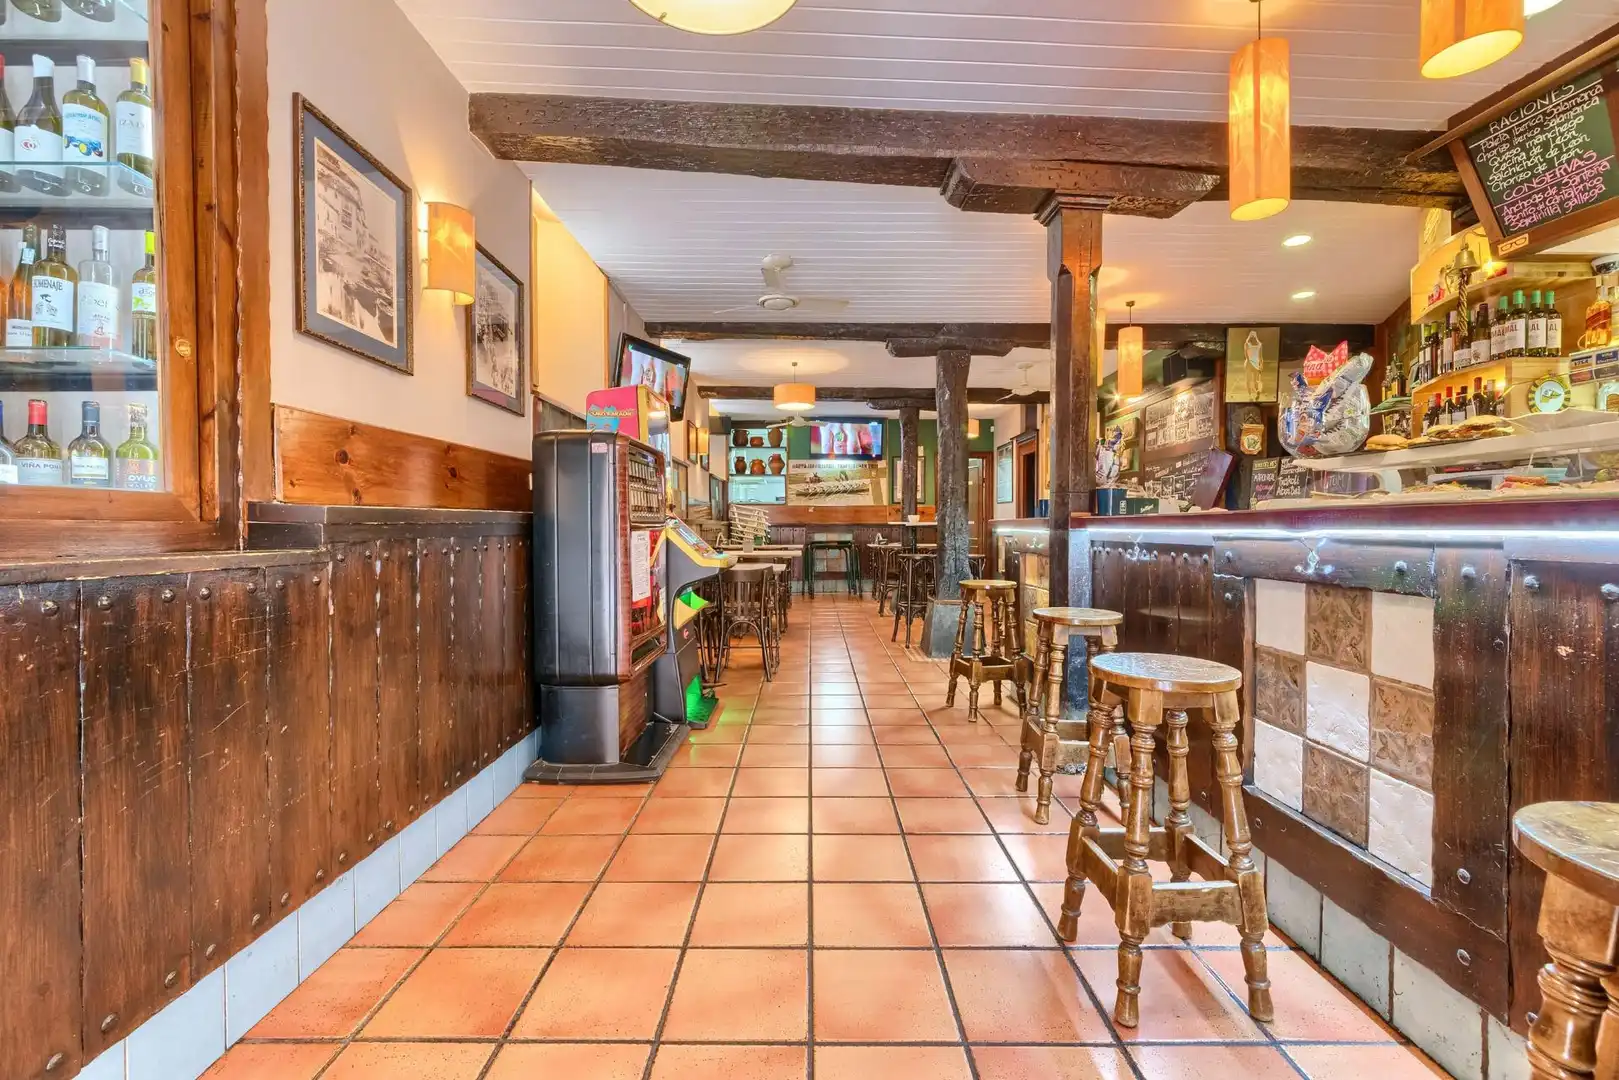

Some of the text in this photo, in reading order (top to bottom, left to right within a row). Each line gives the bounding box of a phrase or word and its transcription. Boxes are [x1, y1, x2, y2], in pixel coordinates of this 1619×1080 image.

[1489, 84, 1575, 133] RACIONES
[1546, 84, 1604, 120] Salamanca
[1476, 143, 1510, 162] Chorizo
[1543, 96, 1600, 130] Salamanca
[1489, 115, 1585, 166] Queso manchego
[1493, 152, 1527, 174] Cecina
[1530, 145, 1543, 156] de
[1546, 147, 1560, 159] de
[1492, 171, 1531, 192] Chorizo
[1534, 163, 1547, 174] de
[1503, 150, 1597, 200] CONSERVAS
[1502, 192, 1544, 216] Anchoas
[1545, 186, 1558, 198] de
[1564, 184, 1606, 213] gallega
[1504, 206, 1536, 225] Bonito
